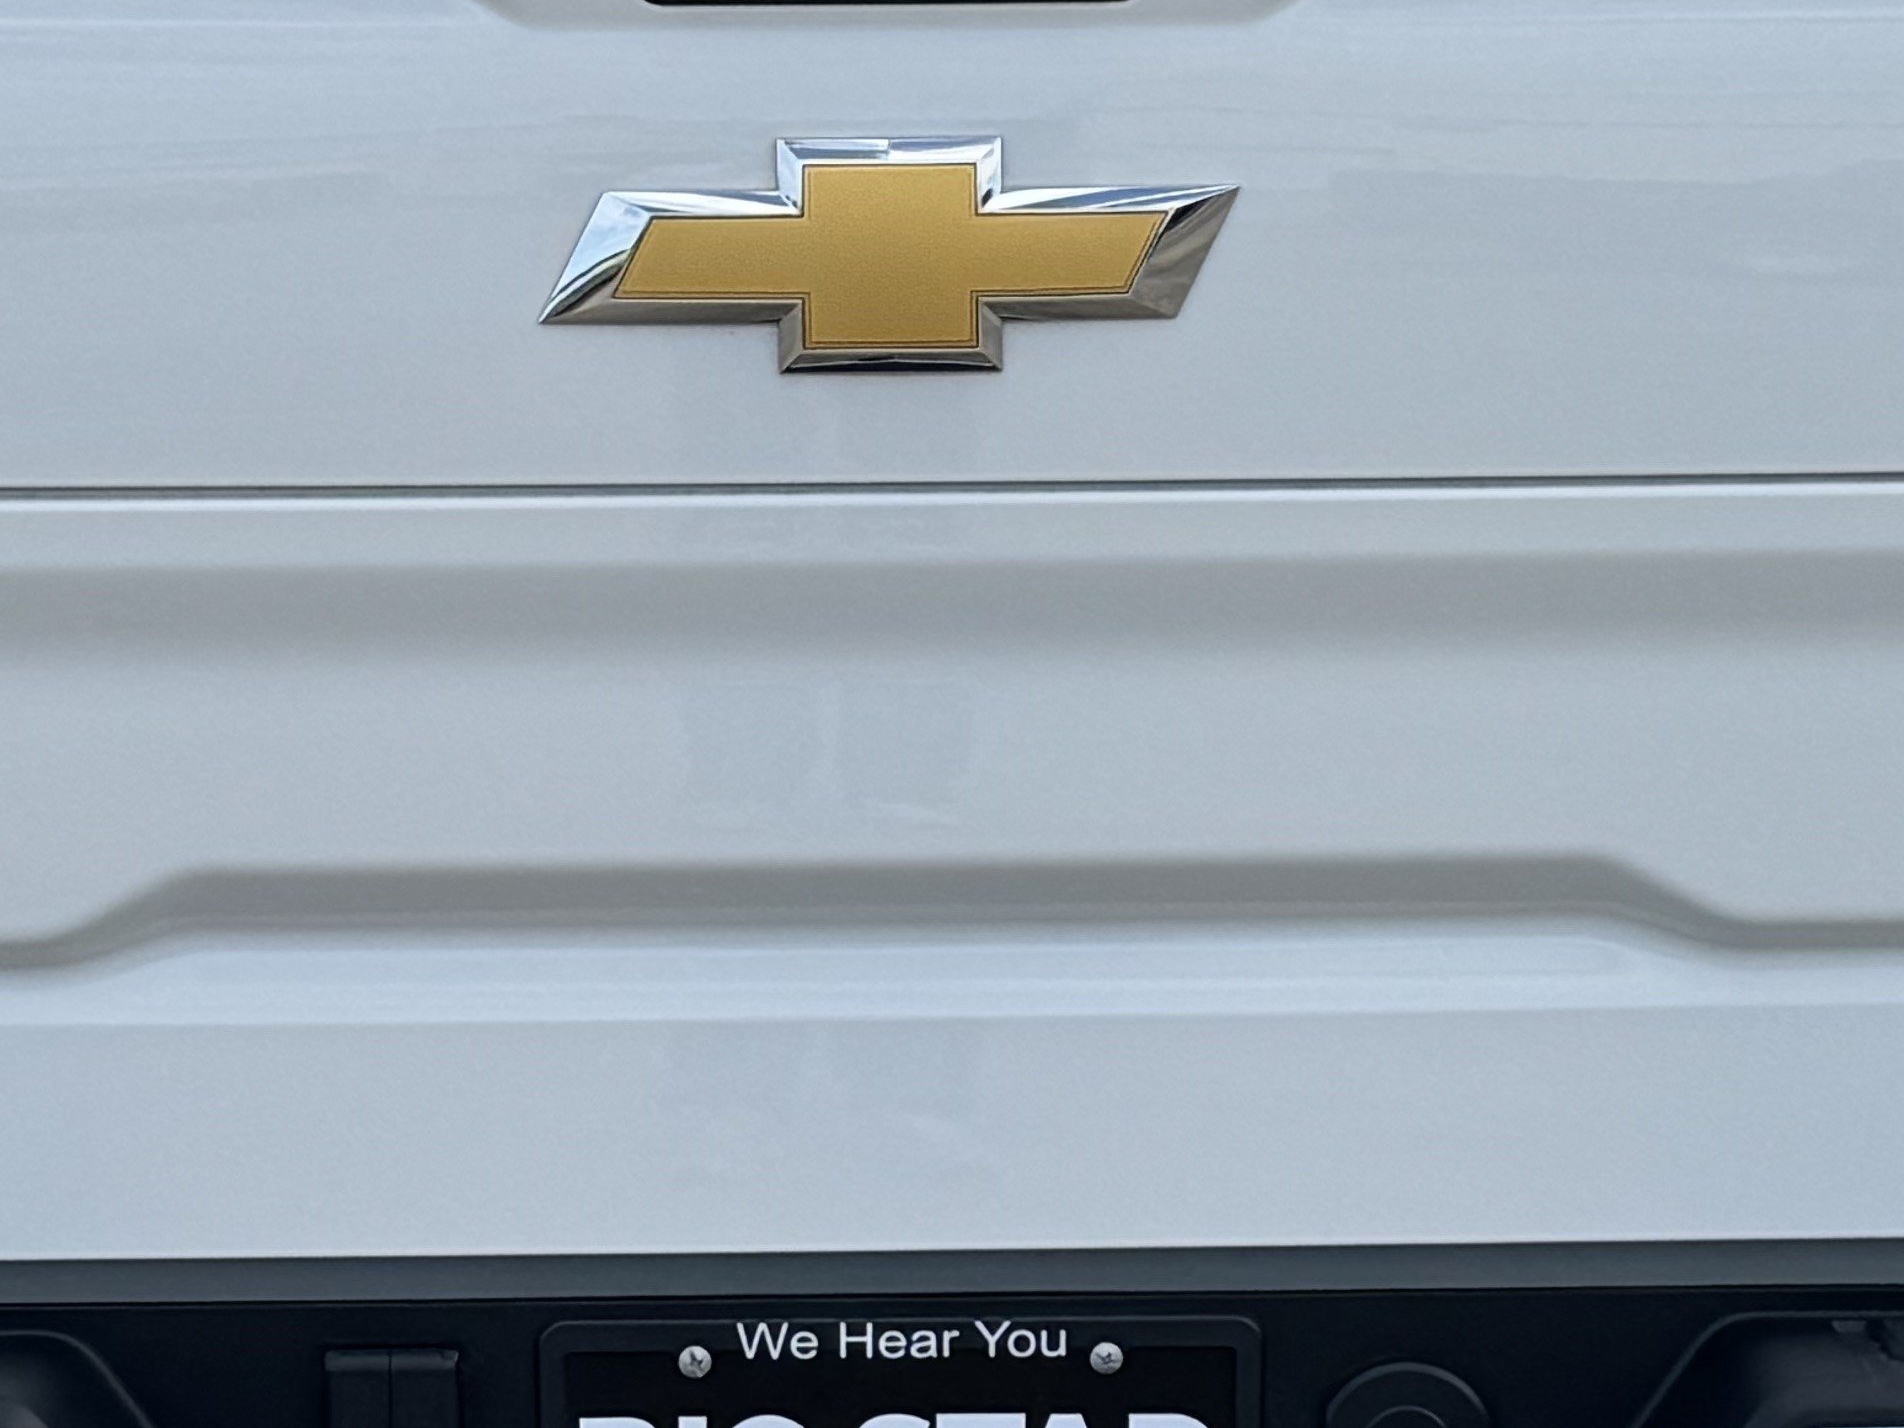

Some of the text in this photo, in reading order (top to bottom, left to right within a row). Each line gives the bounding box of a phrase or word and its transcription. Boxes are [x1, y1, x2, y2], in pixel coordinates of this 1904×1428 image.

[737, 1320, 1067, 1360] We Hear You
